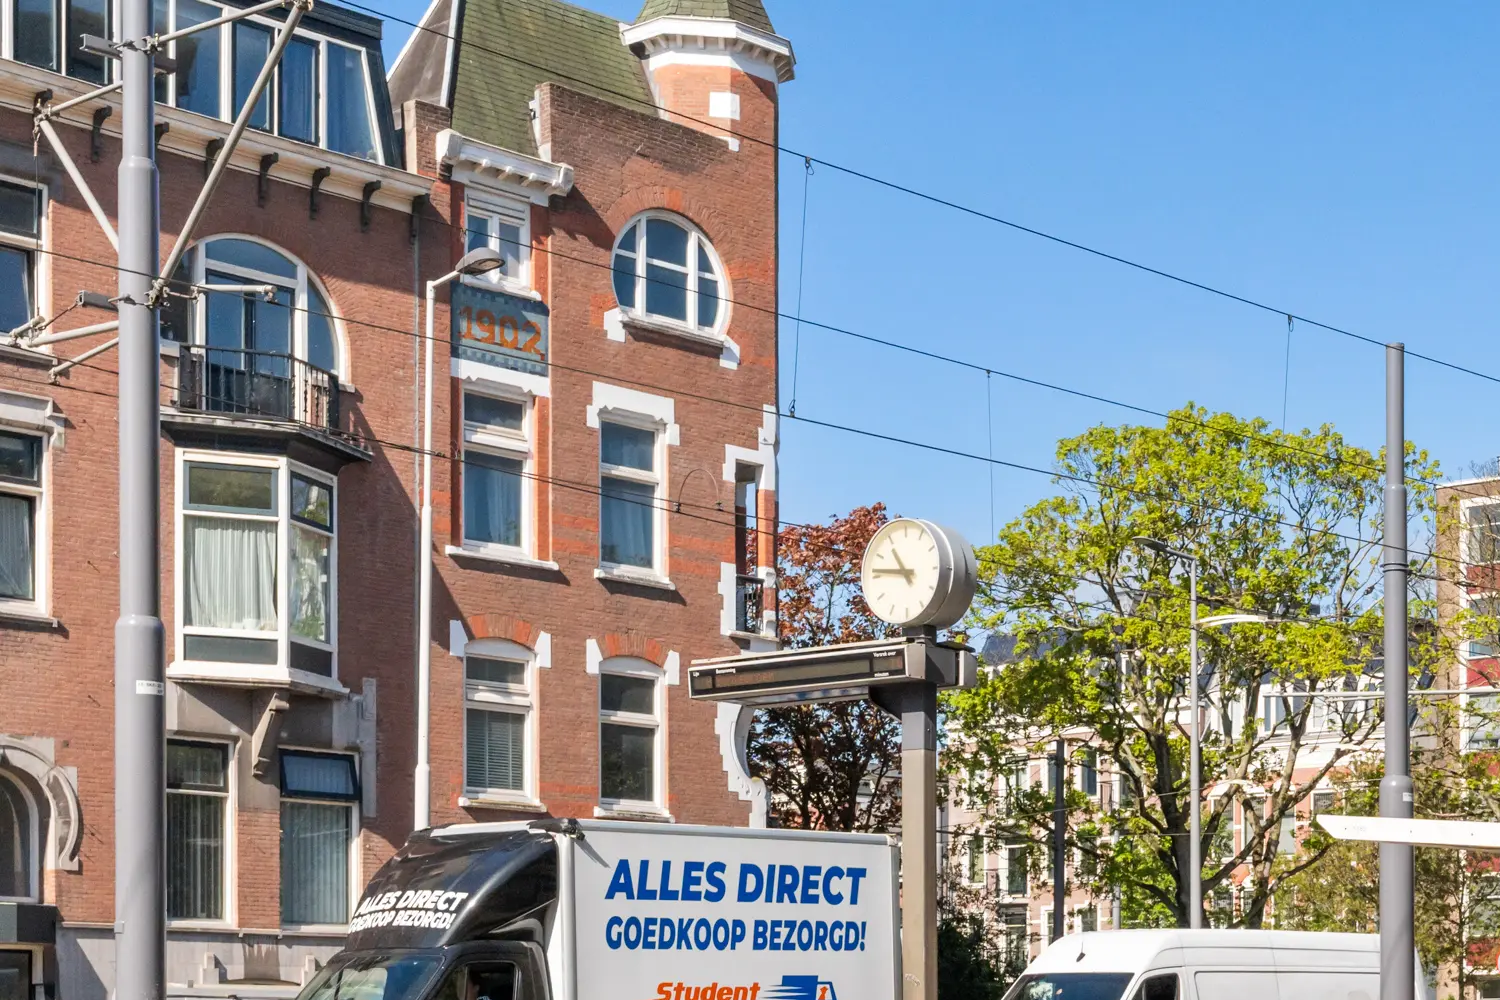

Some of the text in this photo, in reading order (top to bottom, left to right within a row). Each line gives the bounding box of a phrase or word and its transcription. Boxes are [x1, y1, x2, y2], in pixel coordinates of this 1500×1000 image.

[458, 305, 546, 361] 1902
[605, 858, 867, 906] ALLES DIRECT
[354, 889, 469, 916] ALLES DIRECT
[349, 909, 457, 934] GOEDKOOP BEZORGD!
[605, 915, 867, 952] GOEDKOOP BEZORGD!
